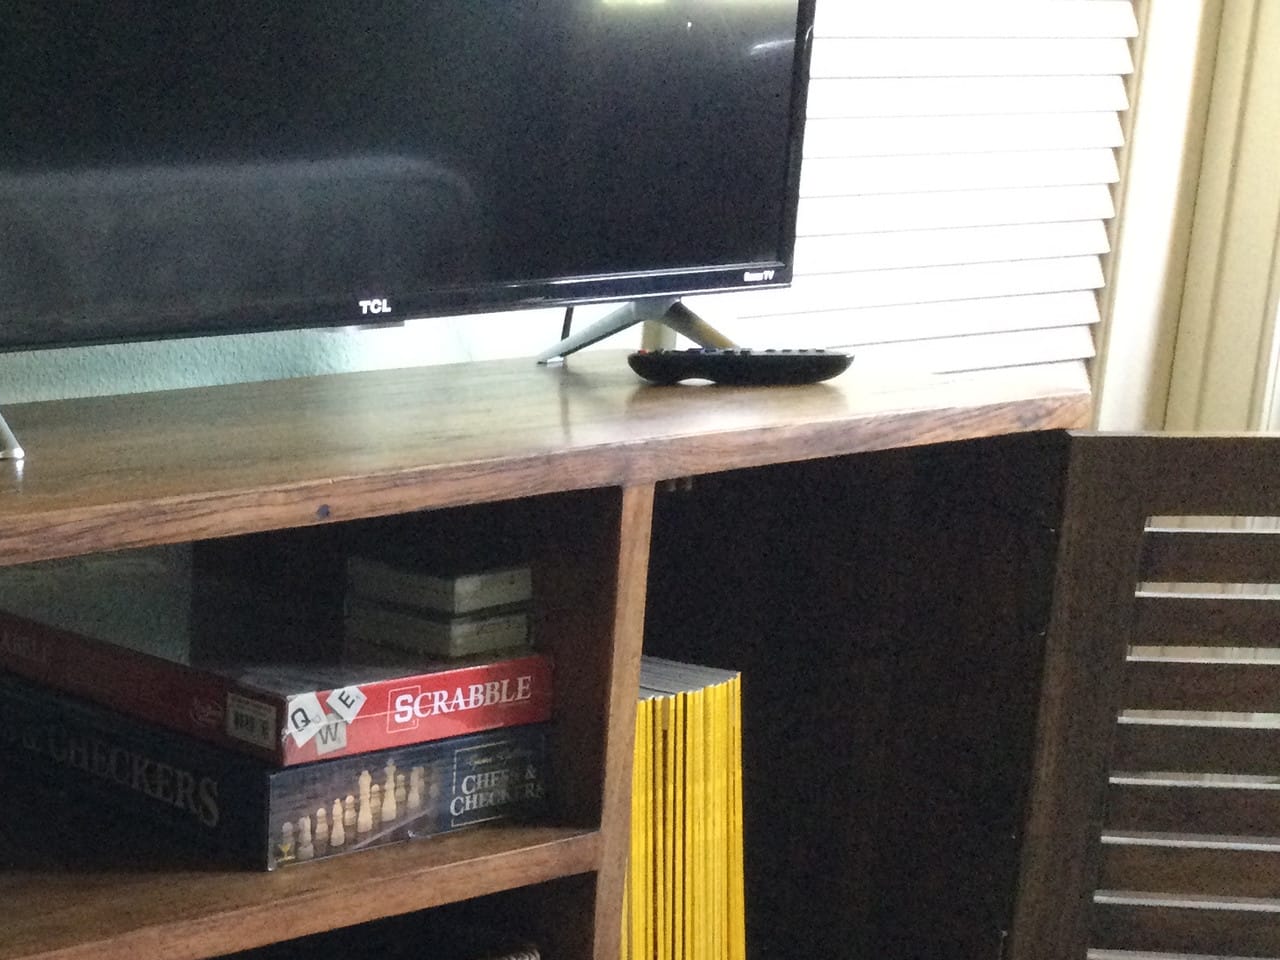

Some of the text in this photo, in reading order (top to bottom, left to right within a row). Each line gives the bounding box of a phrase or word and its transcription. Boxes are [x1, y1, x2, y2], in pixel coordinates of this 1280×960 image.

[358, 299, 392, 314] TCL
[338, 690, 355, 709] E
[394, 675, 532, 724] SCRABBLE
[291, 707, 311, 732] Q
[318, 723, 338, 744] W
[462, 767, 519, 795] CHES
